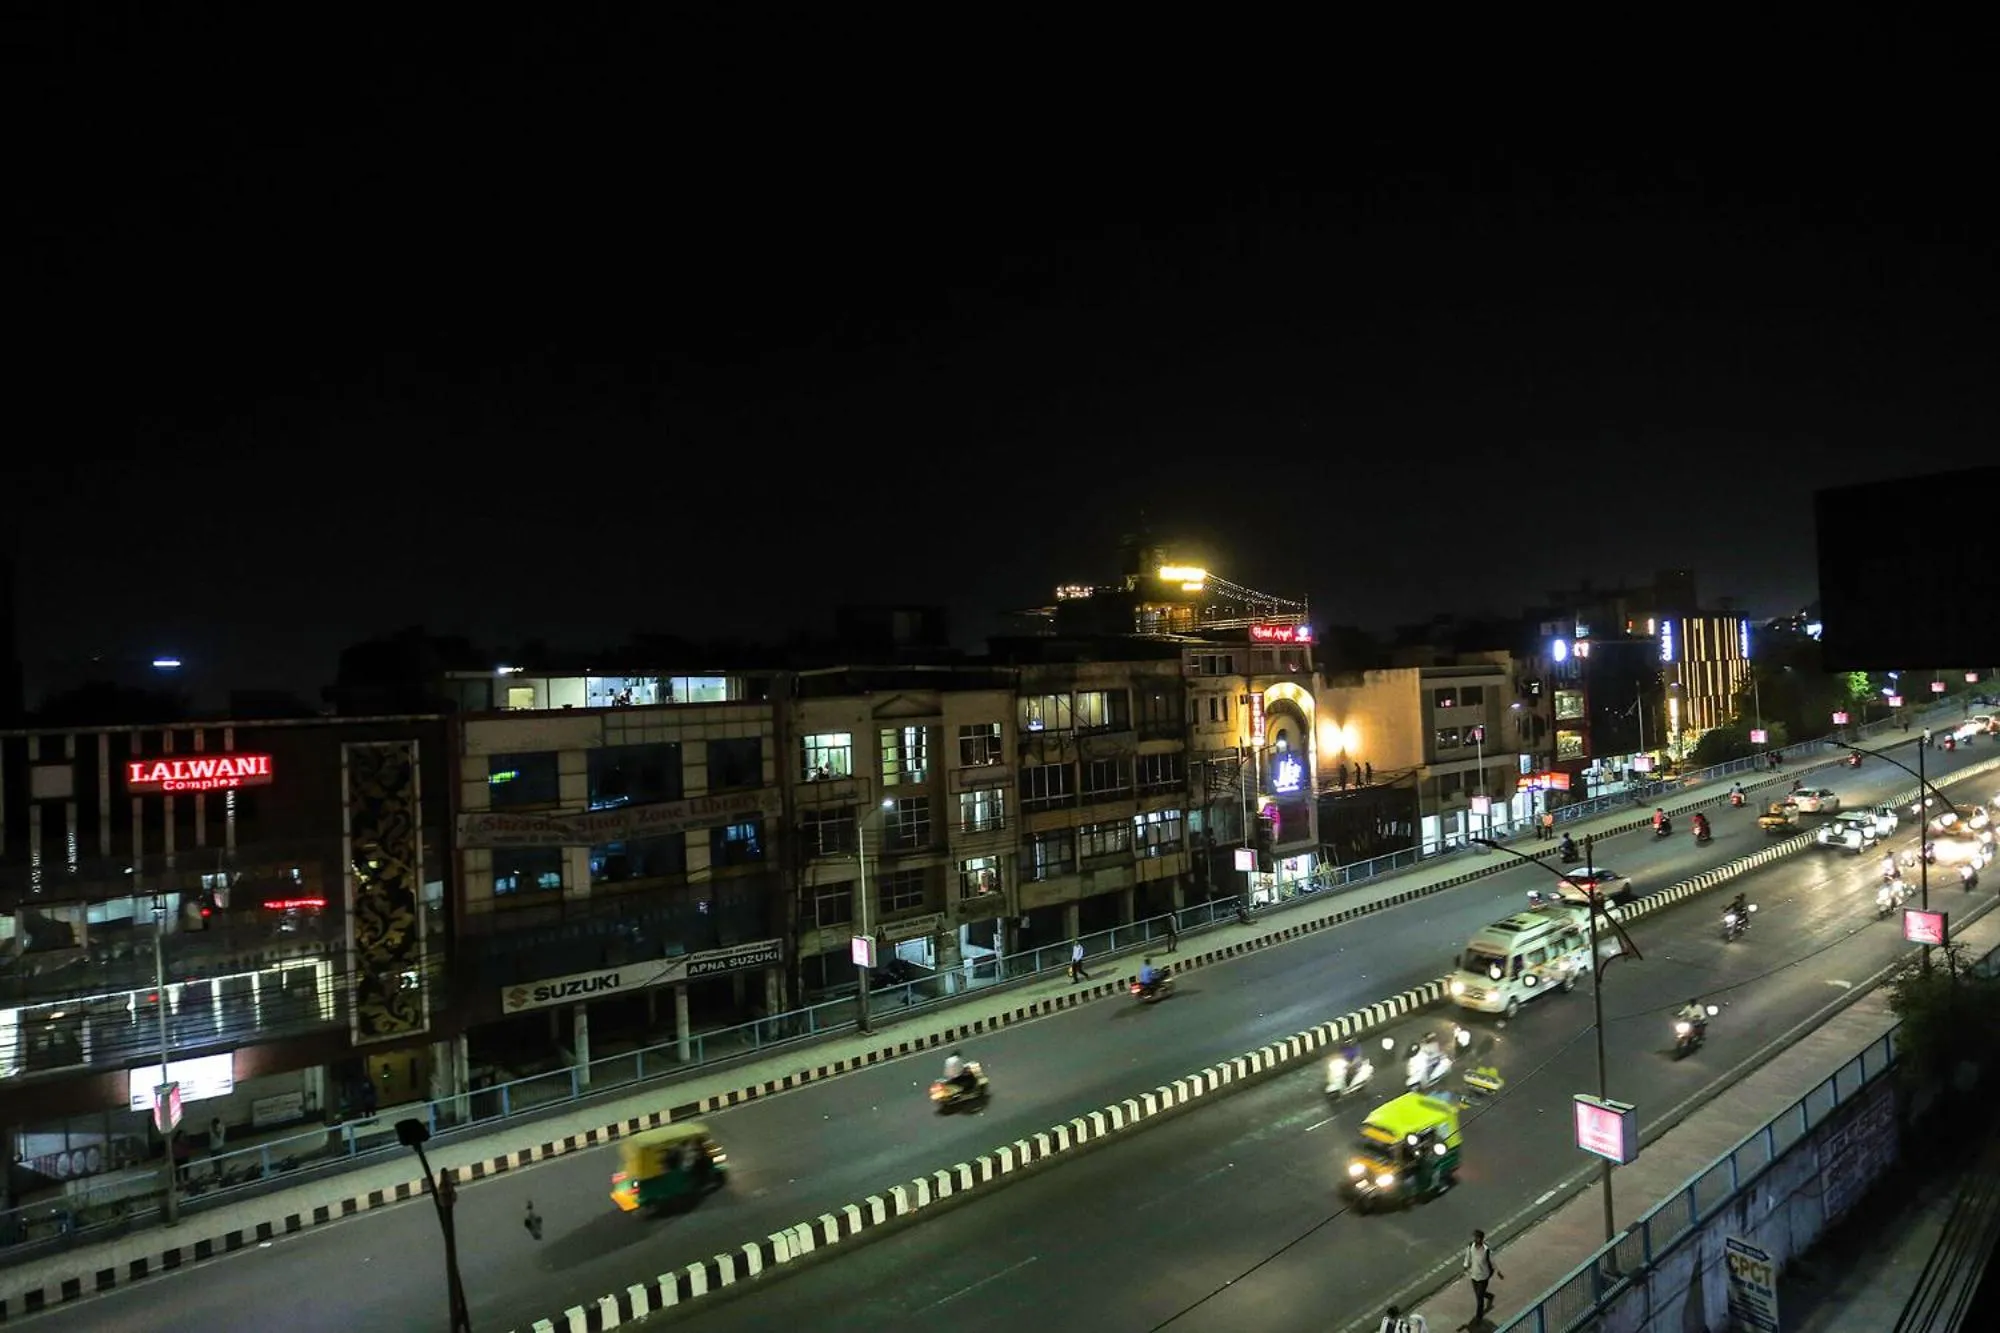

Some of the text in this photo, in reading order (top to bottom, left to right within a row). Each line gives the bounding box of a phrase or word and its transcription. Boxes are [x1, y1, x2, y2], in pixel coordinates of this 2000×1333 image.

[129, 757, 269, 783] LALWANI
[163, 777, 240, 791] Complex
[636, 806, 685, 823] Zone
[688, 961, 726, 975] APNA
[728, 951, 779, 968] SUZUKI
[533, 973, 620, 1002] SUZUKI
[1727, 1252, 1772, 1286] CPCT
